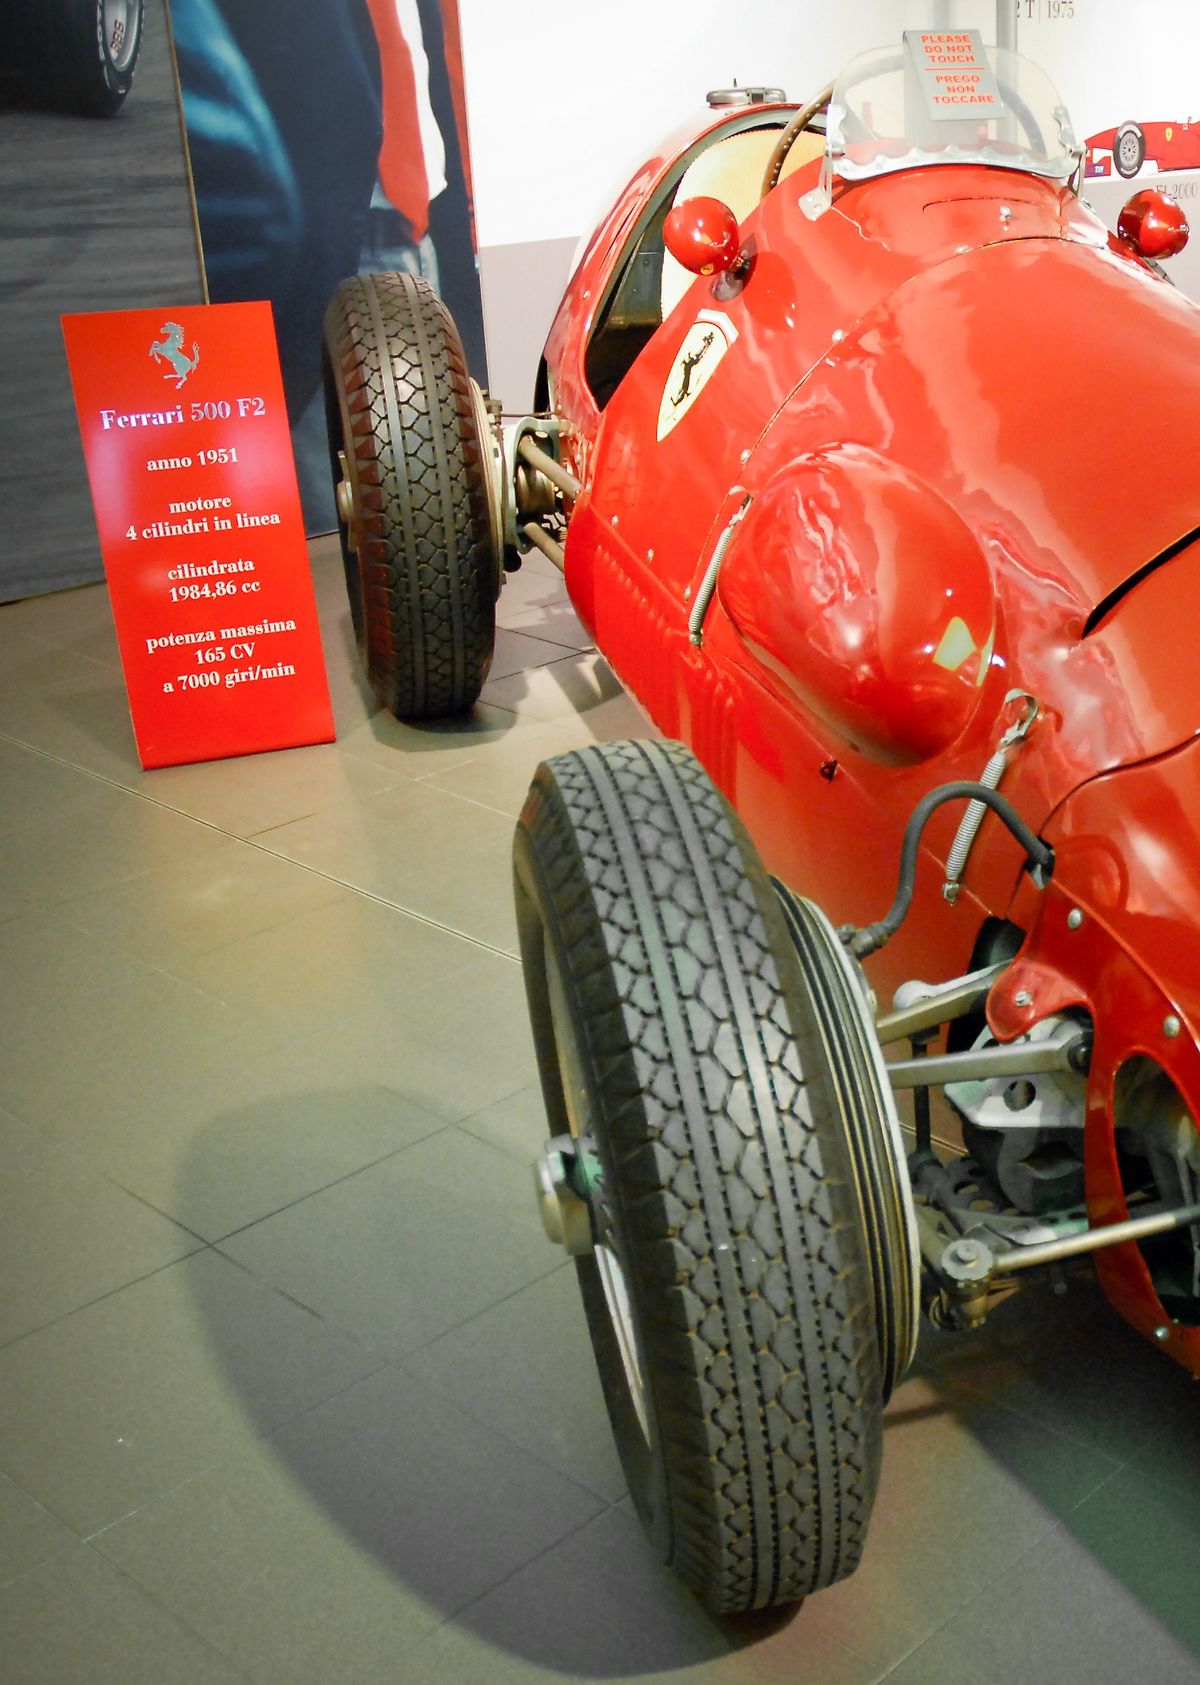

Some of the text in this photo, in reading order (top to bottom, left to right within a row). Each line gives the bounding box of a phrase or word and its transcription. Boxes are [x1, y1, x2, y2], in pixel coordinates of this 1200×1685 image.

[1047, 0, 1075, 19] 1975
[921, 34, 971, 43] PLEASE
[924, 45, 973, 53] DO NOT
[929, 55, 975, 63] TOUCH
[935, 75, 980, 83] PREGO
[947, 85, 975, 93] NON
[933, 95, 995, 103] TOCCARE
[100, 397, 267, 430] Ferrari 500 F2
[146, 448, 239, 472] anno 1951
[168, 497, 233, 514] motore
[125, 512, 281, 541] 4 cilindri in linea
[167, 558, 256, 581] cilindrata
[169, 580, 261, 603] 1984,86 cc
[146, 619, 297, 654] potenza massima
[194, 642, 256, 665] 165 CV
[163, 662, 296, 693] a 7000 giri/min
